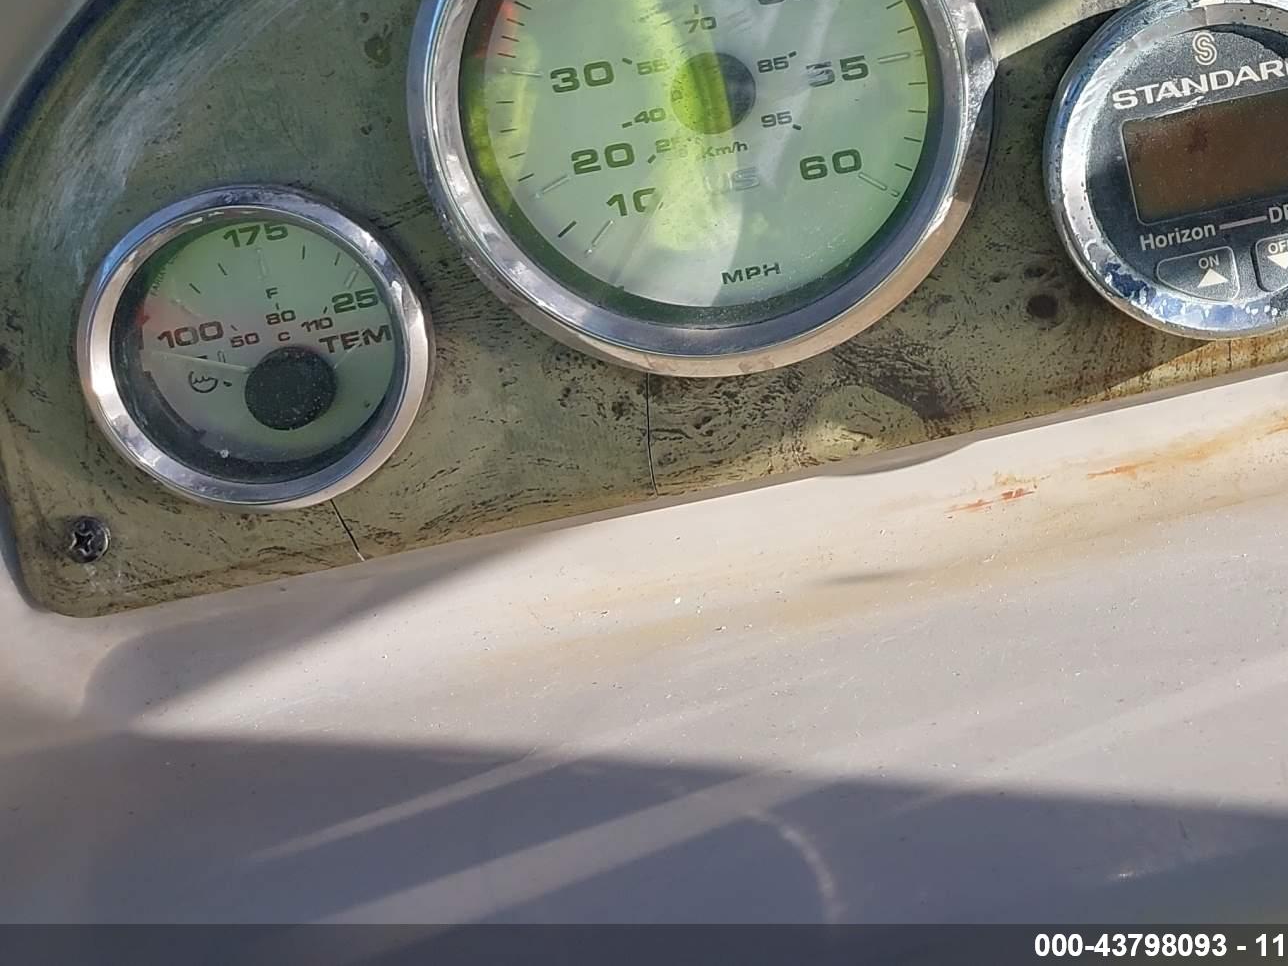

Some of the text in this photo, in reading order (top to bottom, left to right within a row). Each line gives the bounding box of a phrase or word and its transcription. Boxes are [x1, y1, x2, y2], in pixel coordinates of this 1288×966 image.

[684, 16, 717, 34] 70
[757, 56, 789, 73] 85
[550, 61, 615, 93] 30
[633, 107, 666, 124] 40
[760, 112, 793, 128] 95
[571, 142, 635, 176] 20
[800, 148, 863, 181] 60
[606, 187, 658, 217] 10
[223, 224, 288, 248] 175
[1140, 222, 1217, 252] Horizon
[1198, 255, 1220, 269] ON
[721, 262, 781, 285] MPH
[266, 287, 279, 300] F
[332, 288, 380, 314] 25
[266, 309, 296, 325] 80
[302, 316, 333, 332] 110
[157, 321, 224, 349] 100
[278, 331, 291, 342] C
